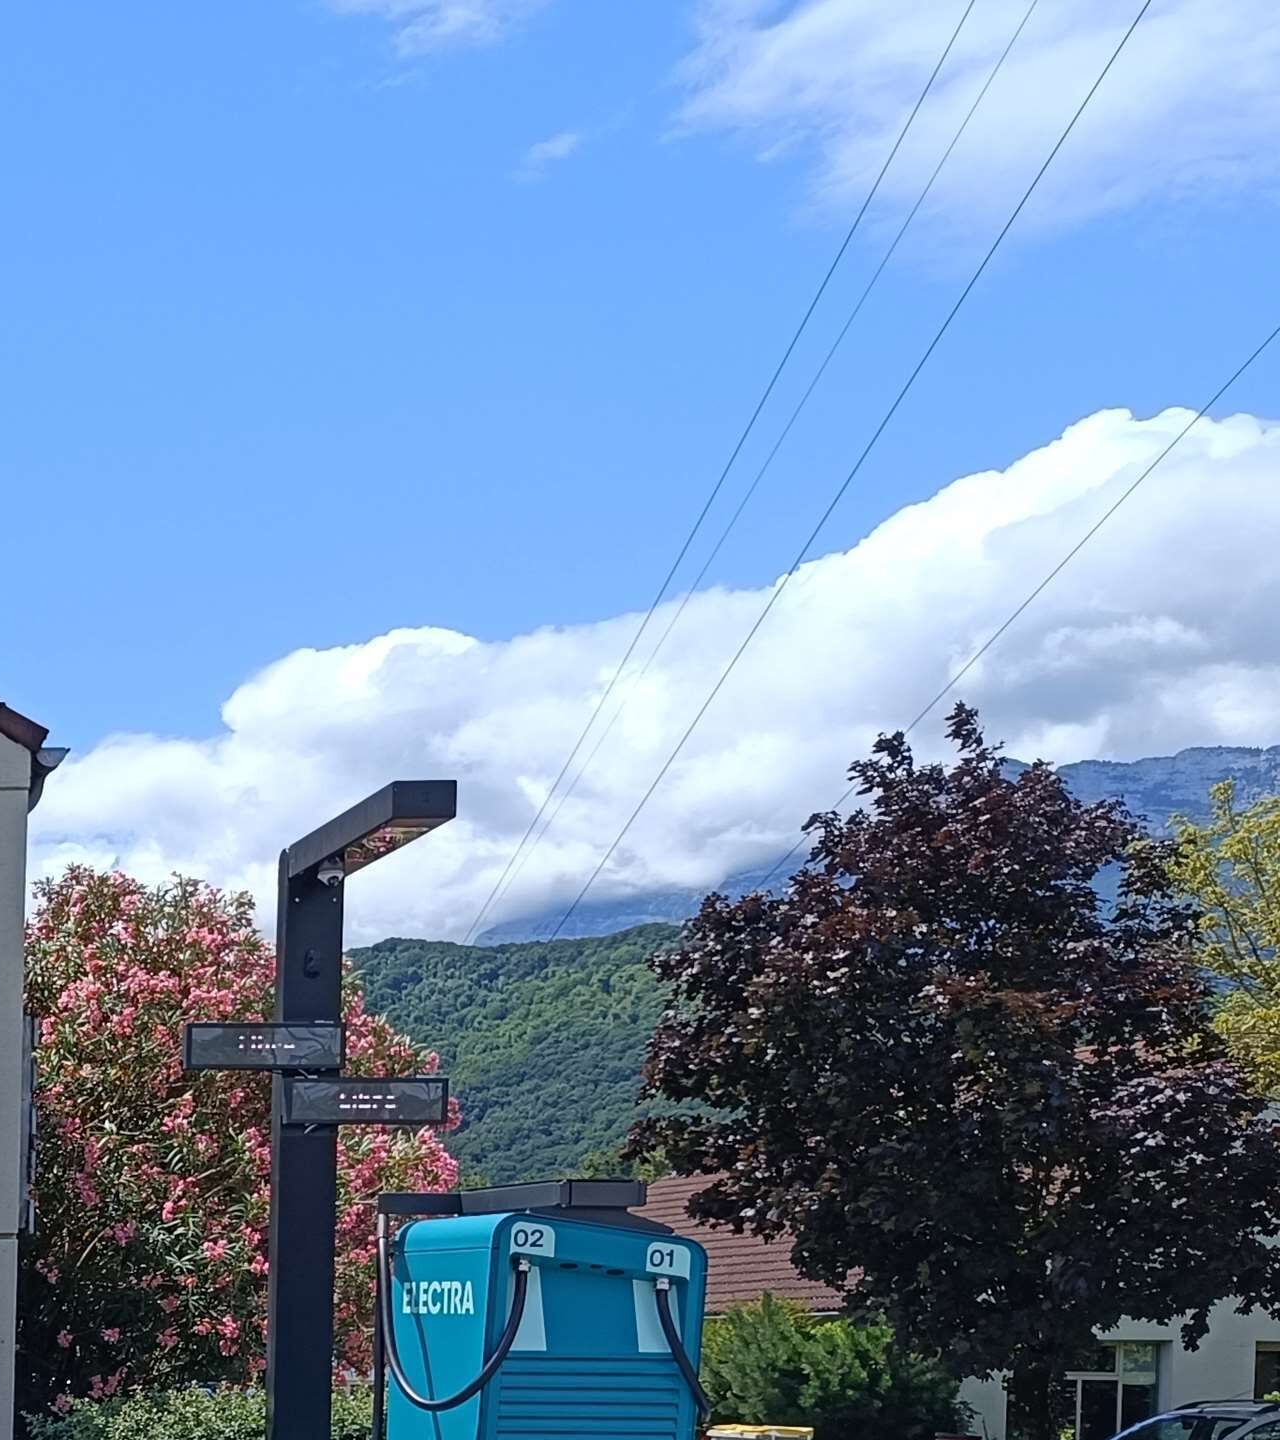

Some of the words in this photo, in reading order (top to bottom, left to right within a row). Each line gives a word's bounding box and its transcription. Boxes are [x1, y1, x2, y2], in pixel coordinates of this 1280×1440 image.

[513, 1228, 544, 1248] 02
[650, 1249, 675, 1268] 01
[402, 1280, 475, 1315] ELECTRA
